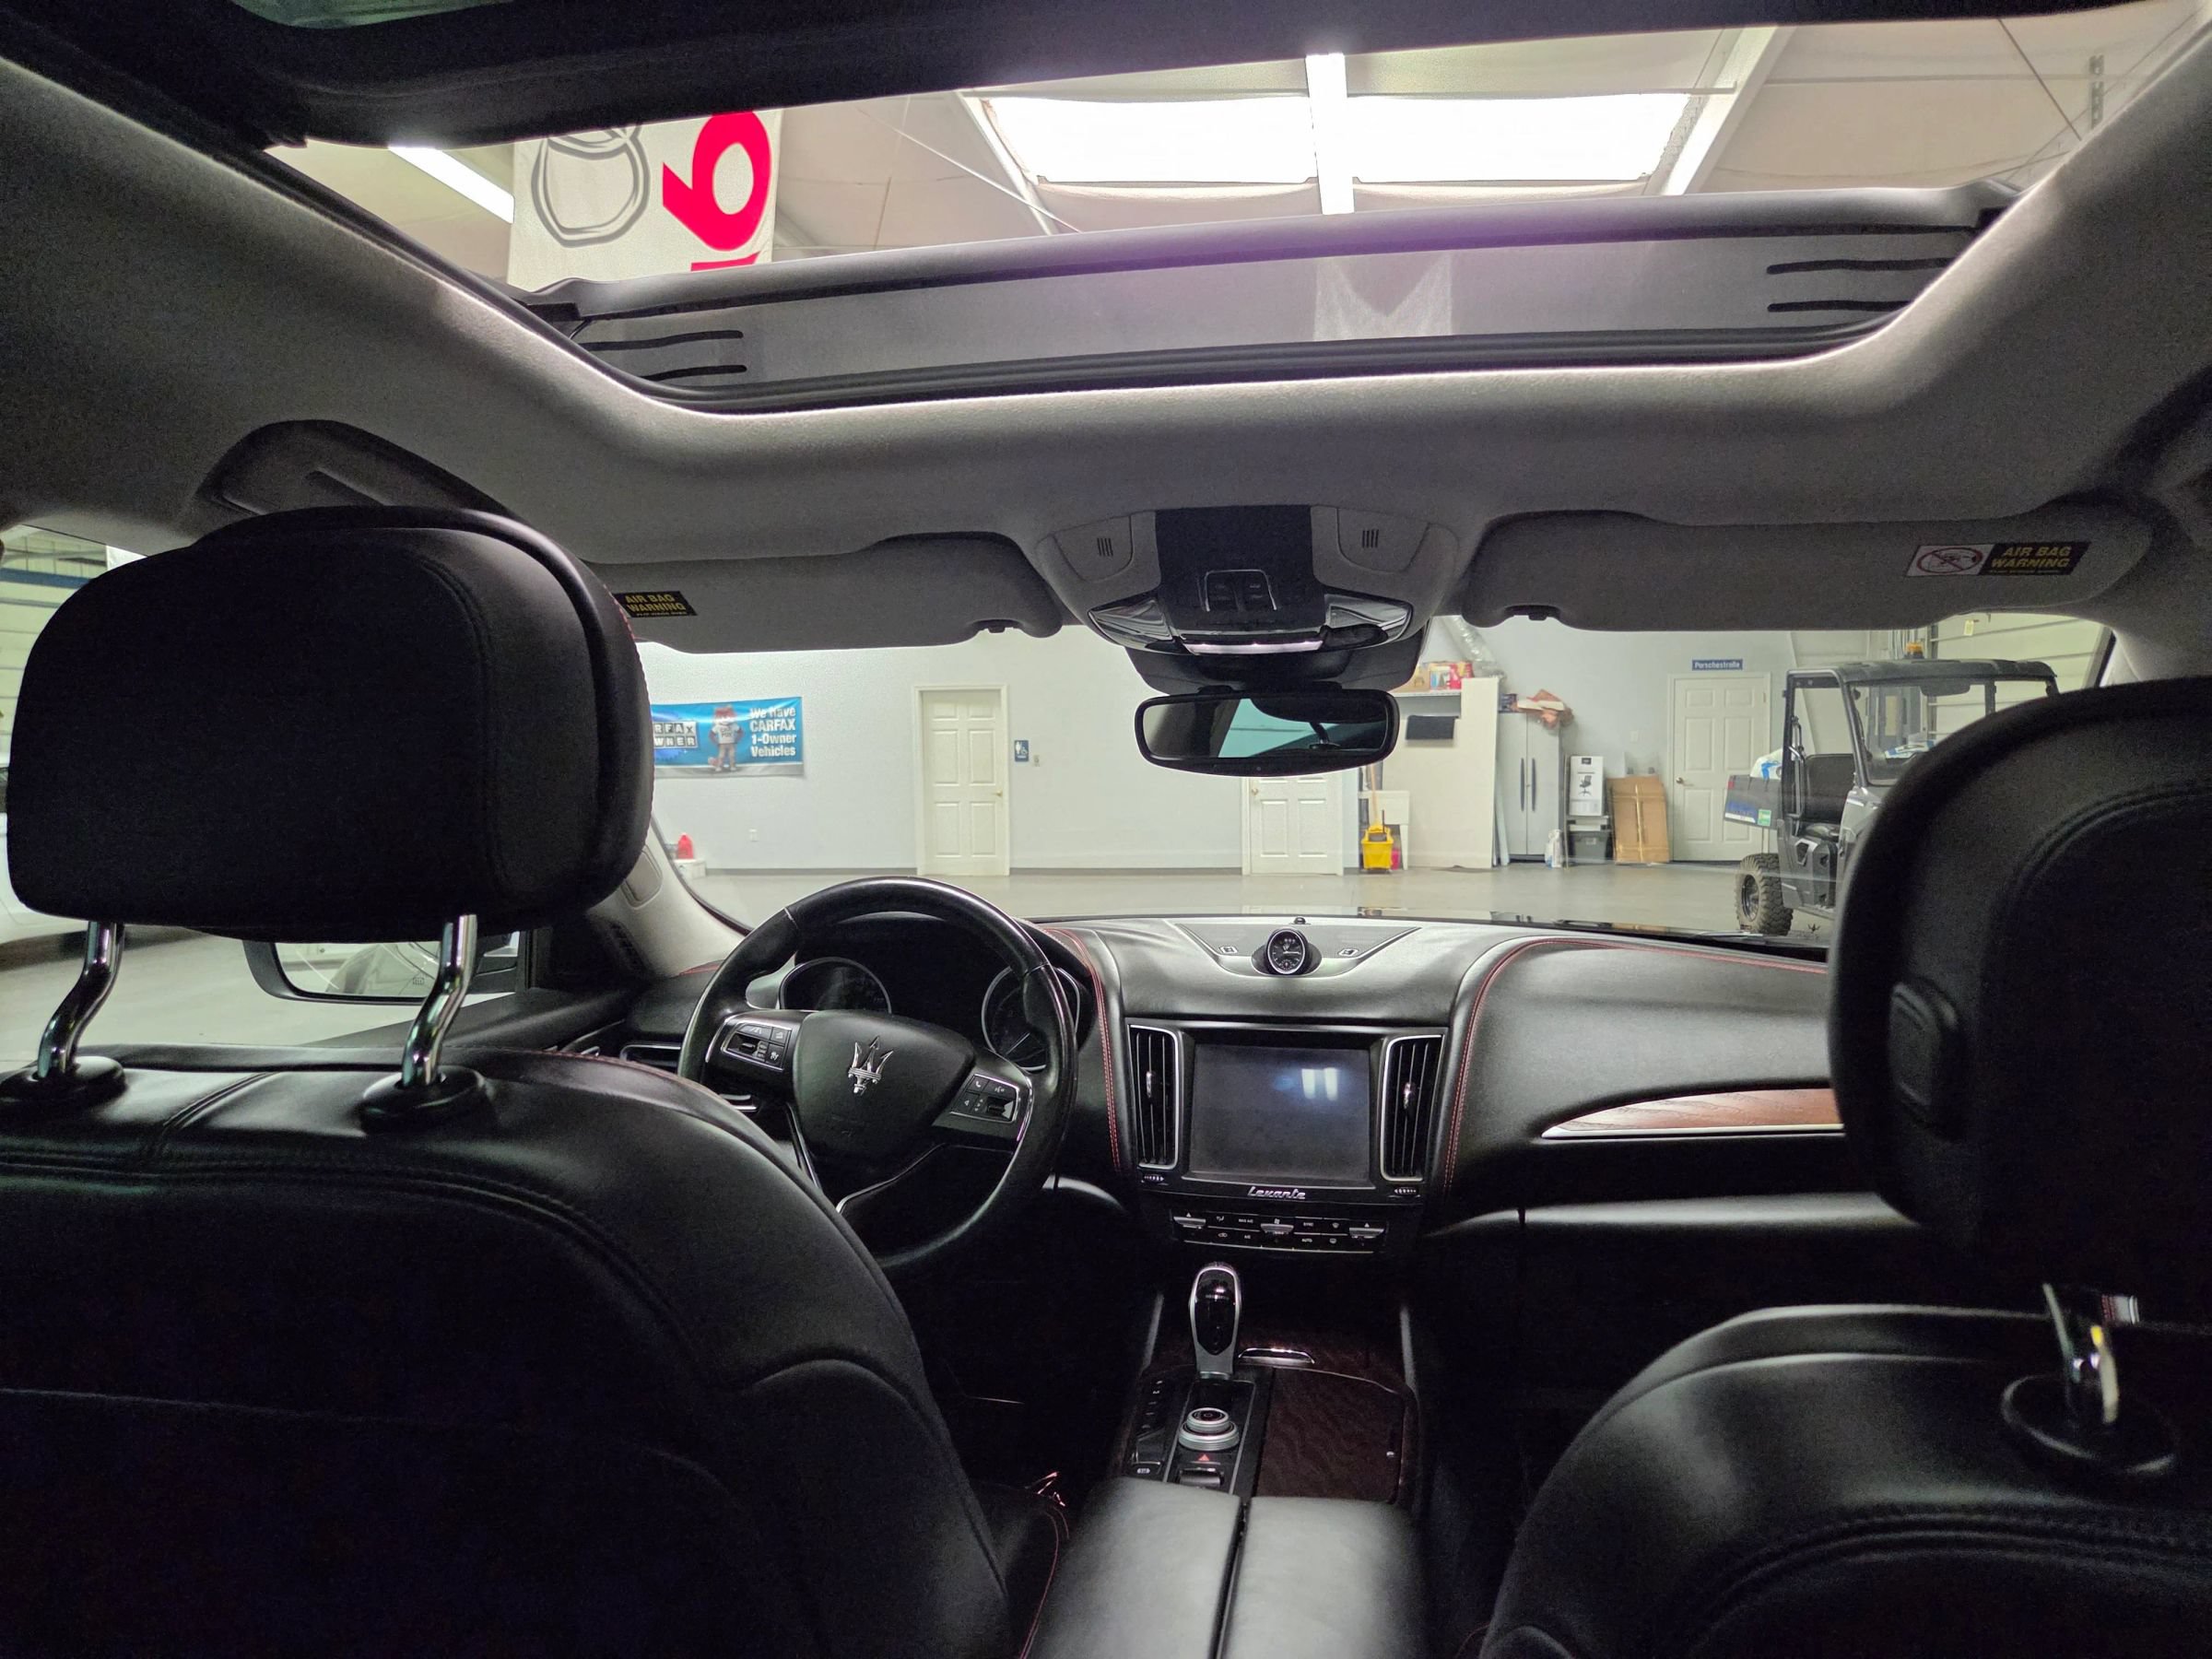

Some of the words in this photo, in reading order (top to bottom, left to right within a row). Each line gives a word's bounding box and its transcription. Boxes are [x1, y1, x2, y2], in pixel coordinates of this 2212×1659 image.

[2004, 547, 2032, 556] AIR
[2036, 547, 2071, 556] BAG
[1992, 559, 2069, 567] WARNING
[626, 594, 647, 603] AIR
[628, 603, 686, 611] WARNING
[750, 708, 767, 719] We
[653, 723, 694, 734] RFAX
[749, 719, 796, 732] CARFAX
[653, 736, 695, 747] WNER
[751, 734, 796, 745] 1-Owner
[750, 745, 796, 757] Vehicles
[1247, 1186, 1305, 1199] Levante
